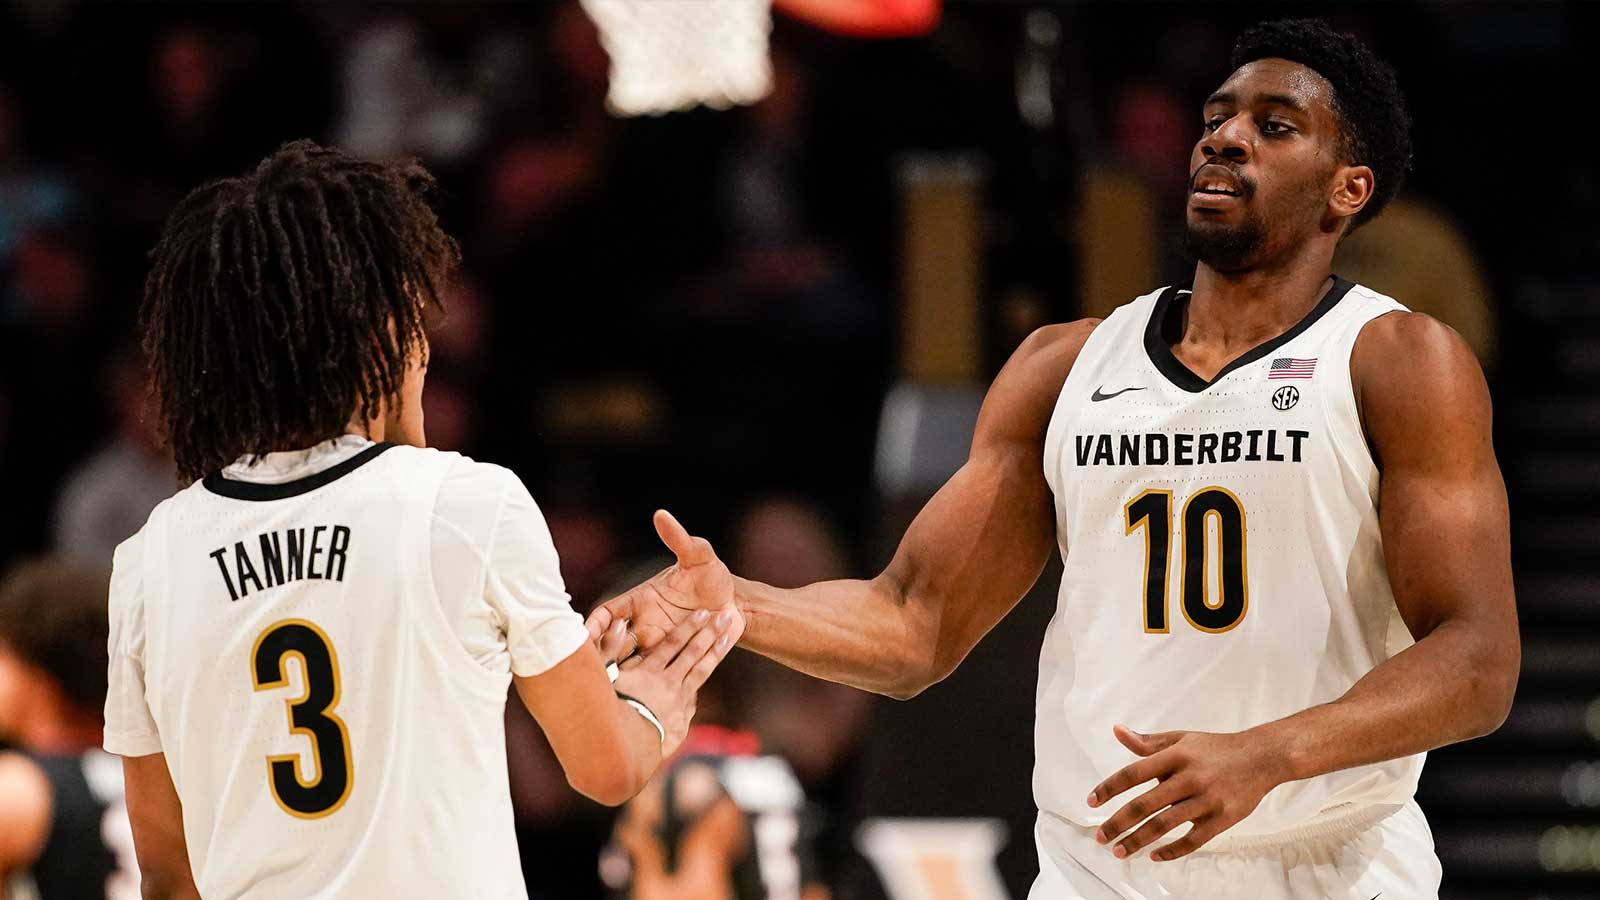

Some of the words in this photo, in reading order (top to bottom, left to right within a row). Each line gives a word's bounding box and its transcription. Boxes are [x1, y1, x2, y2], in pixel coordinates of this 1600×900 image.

[1273, 387, 1299, 409] SEC
[1075, 430, 1309, 467] VANDERBILT
[209, 525, 351, 602] TANNER
[1124, 486, 1249, 634] 10
[250, 618, 354, 820] 3
